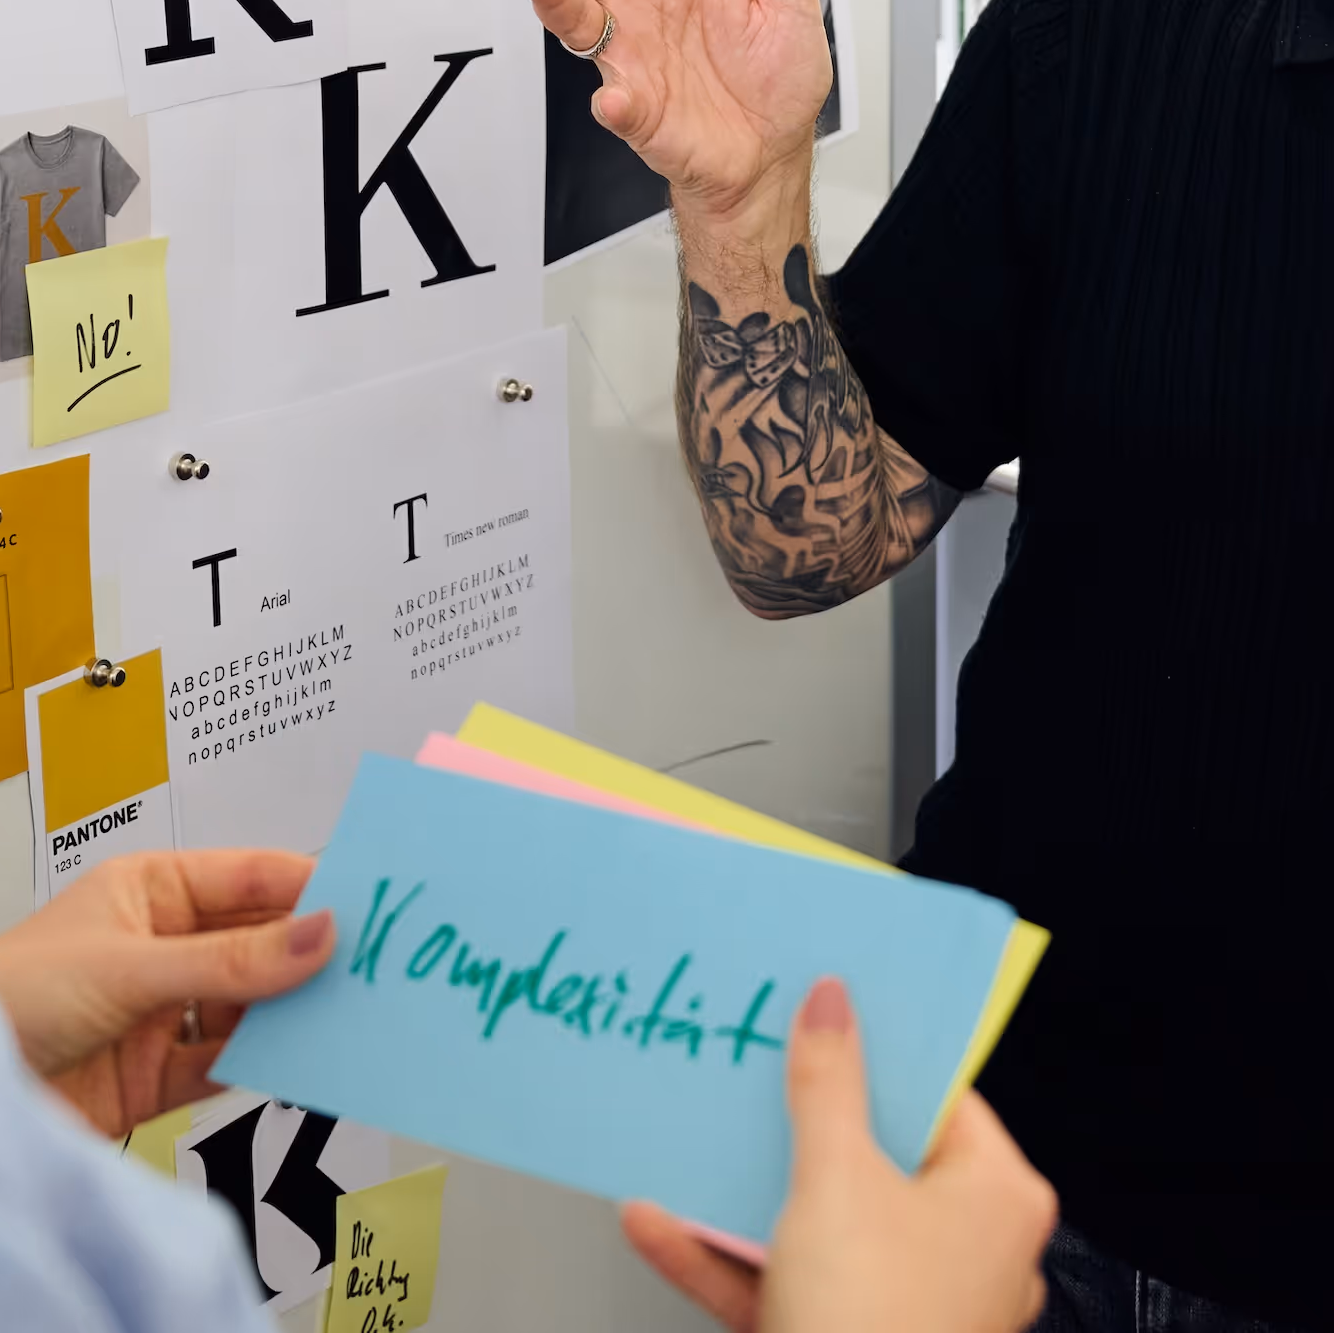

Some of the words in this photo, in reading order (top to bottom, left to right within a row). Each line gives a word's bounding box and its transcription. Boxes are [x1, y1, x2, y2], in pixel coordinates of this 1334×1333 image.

[295, 47, 496, 317] K
[20, 186, 81, 264] K
[9, 533, 18, 546] C
[393, 492, 428, 564] T
[443, 527, 474, 548] Times
[476, 520, 497, 537] new
[498, 507, 530, 528] roman
[192, 547, 238, 627] T
[260, 588, 291, 612] Arial
[55, 858, 72, 874] 123
[74, 854, 82, 866] C
[351, 1220, 374, 1260] Die
